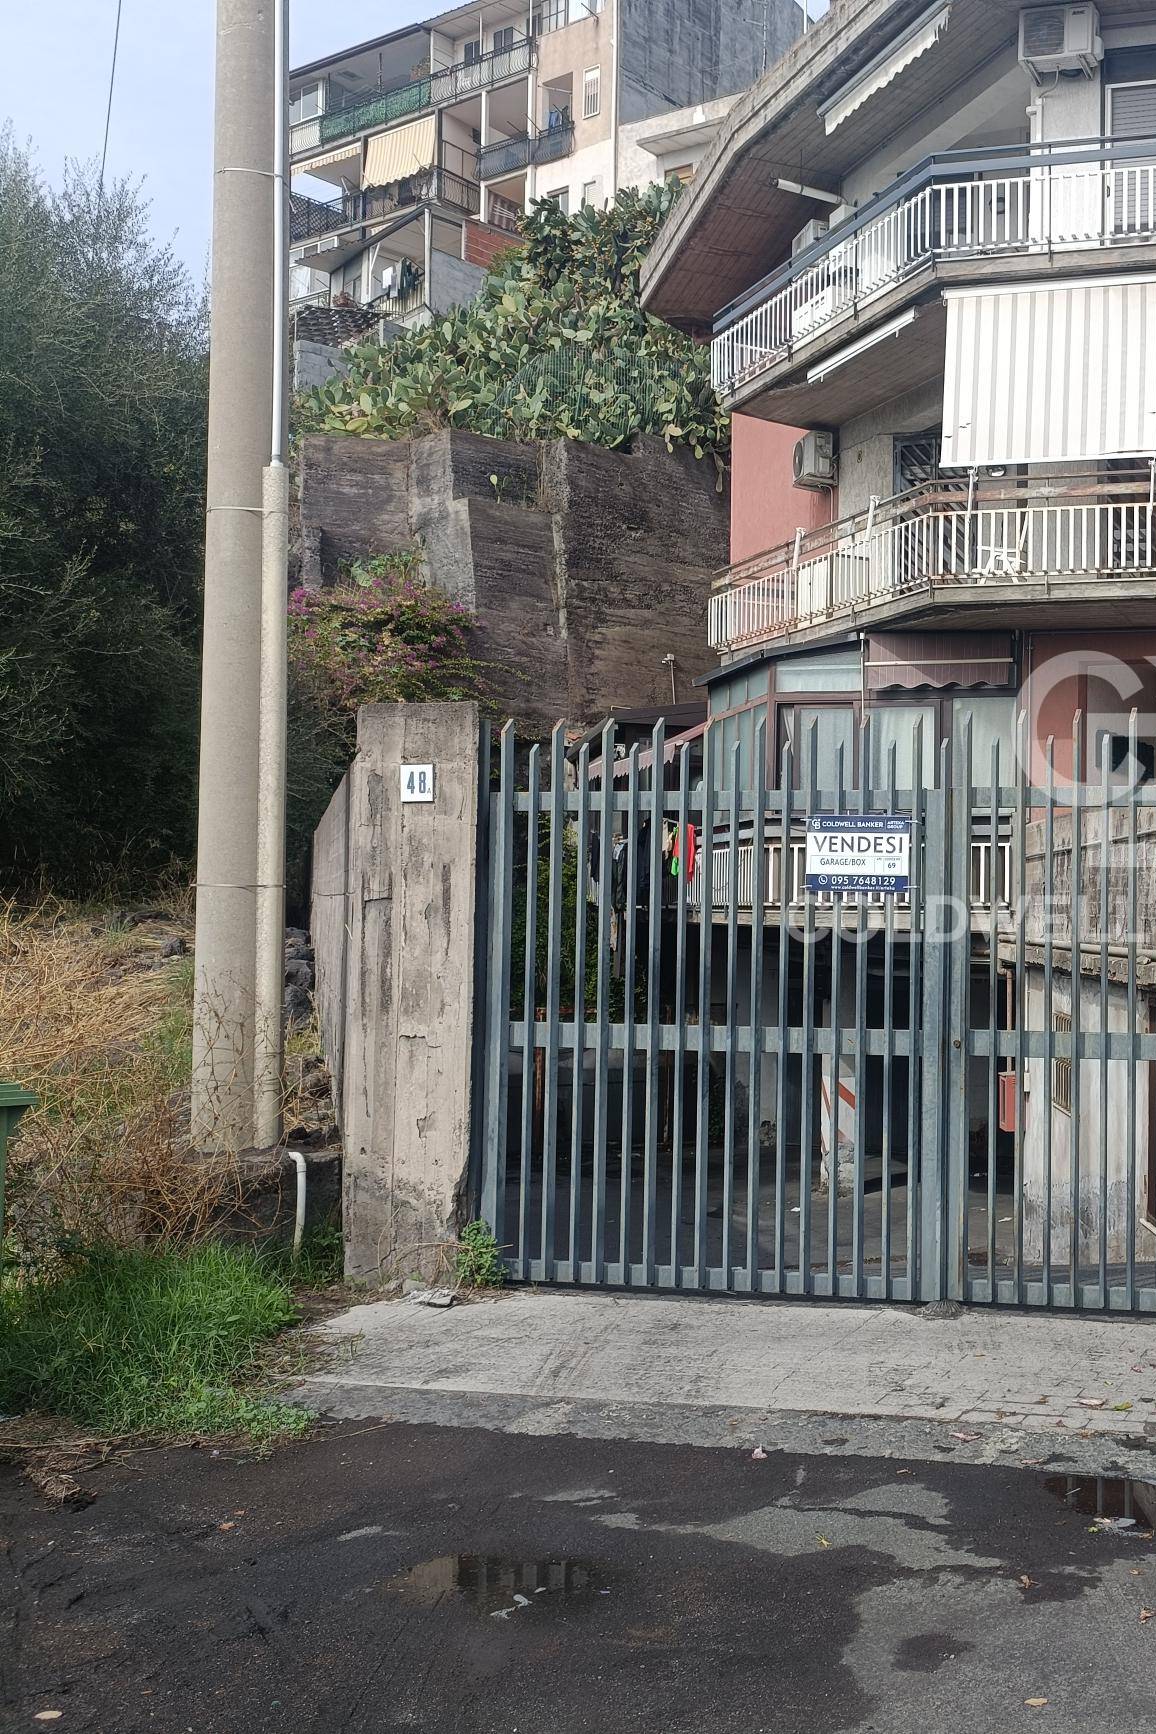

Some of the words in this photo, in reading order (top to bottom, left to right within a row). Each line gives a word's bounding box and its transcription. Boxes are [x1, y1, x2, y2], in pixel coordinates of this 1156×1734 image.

[813, 835, 903, 854] VENDESI
[820, 858, 866, 866] GARAGE/BOX
[831, 876, 849, 885] 095
[853, 876, 896, 886] 7648129
